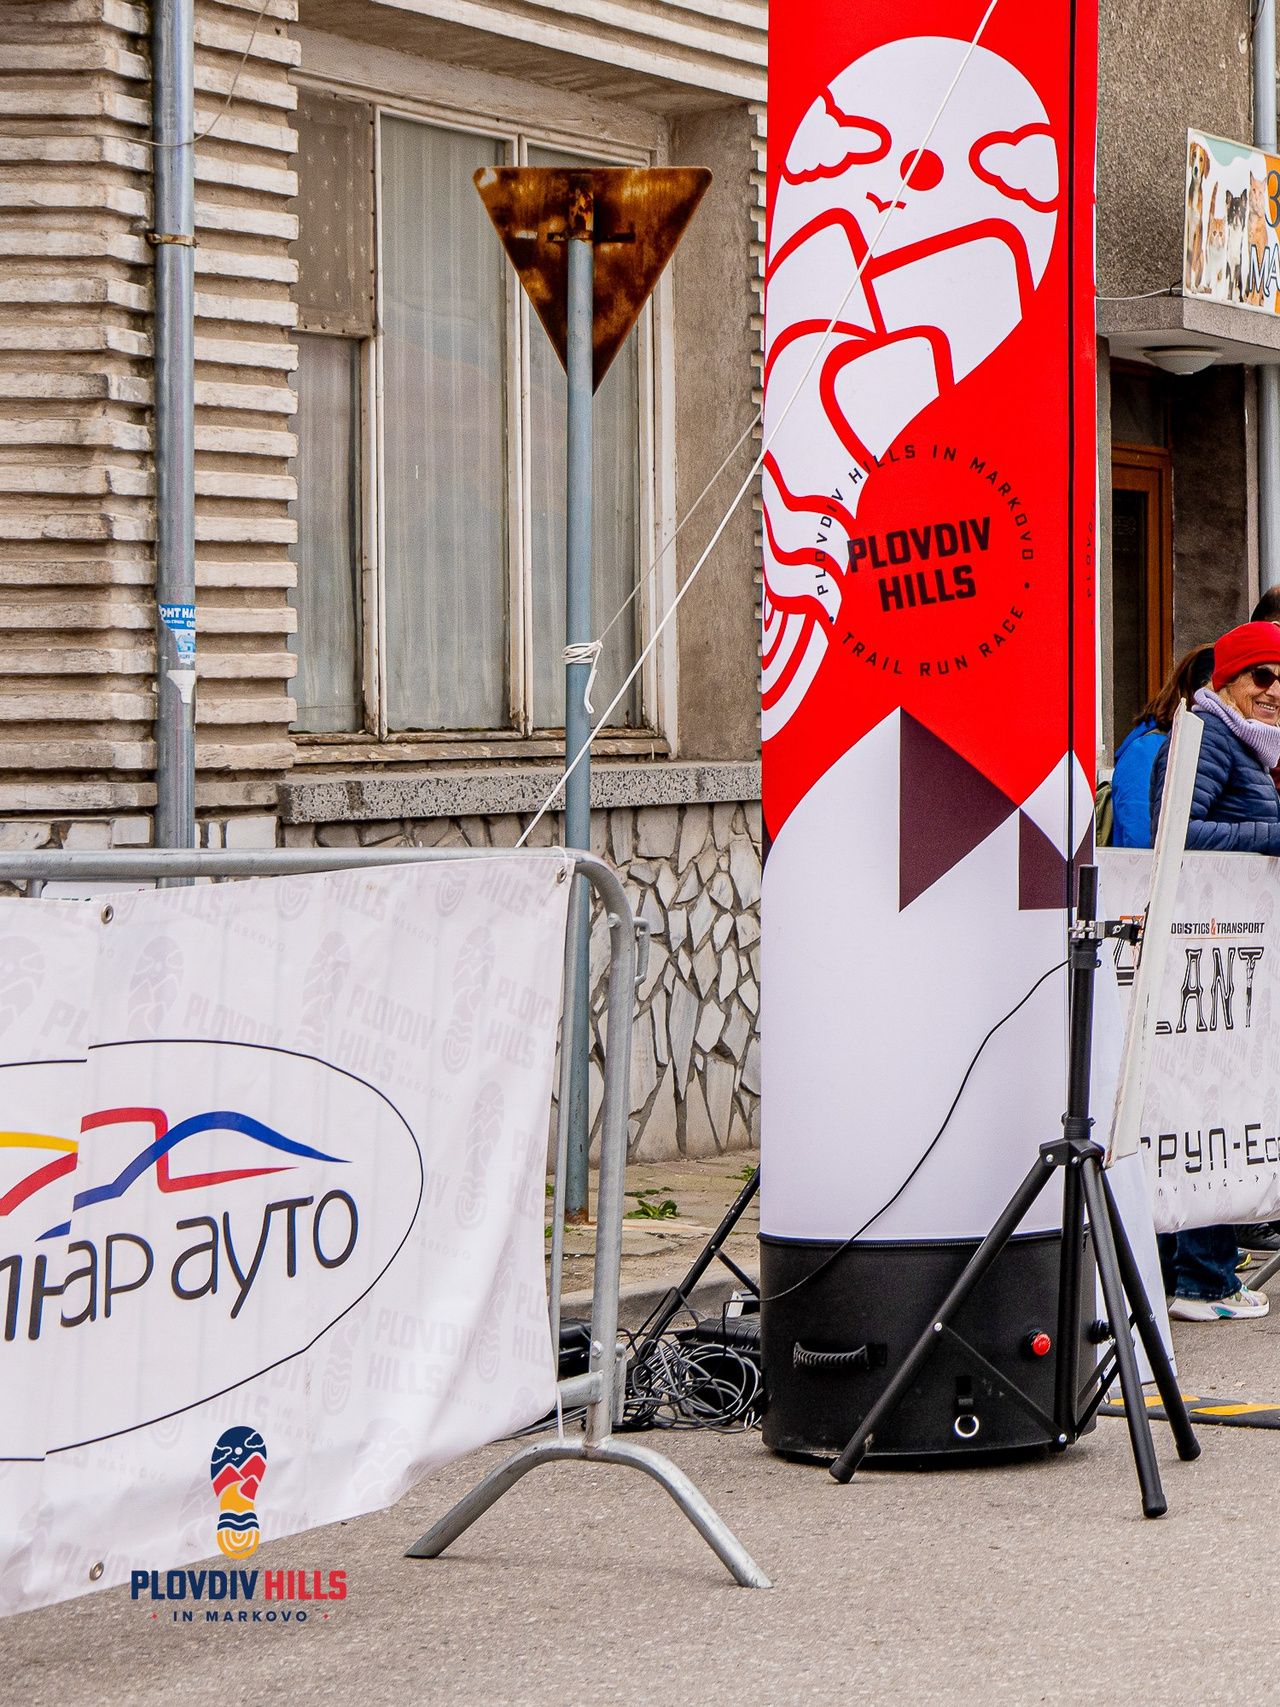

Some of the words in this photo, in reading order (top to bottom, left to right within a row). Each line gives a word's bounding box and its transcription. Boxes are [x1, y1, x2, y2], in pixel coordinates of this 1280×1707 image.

[815, 488, 844, 596] PLOVDIV
[848, 445, 916, 484] HILLS
[932, 444, 957, 462] IN
[969, 456, 1034, 560] MARKOVO
[847, 516, 991, 573] PLOVDIV
[878, 564, 976, 612] HILLS
[842, 631, 902, 675] TRAIL
[919, 655, 968, 676] RUN
[978, 605, 1024, 658] RACE
[171, 1189, 359, 1320] ауто
